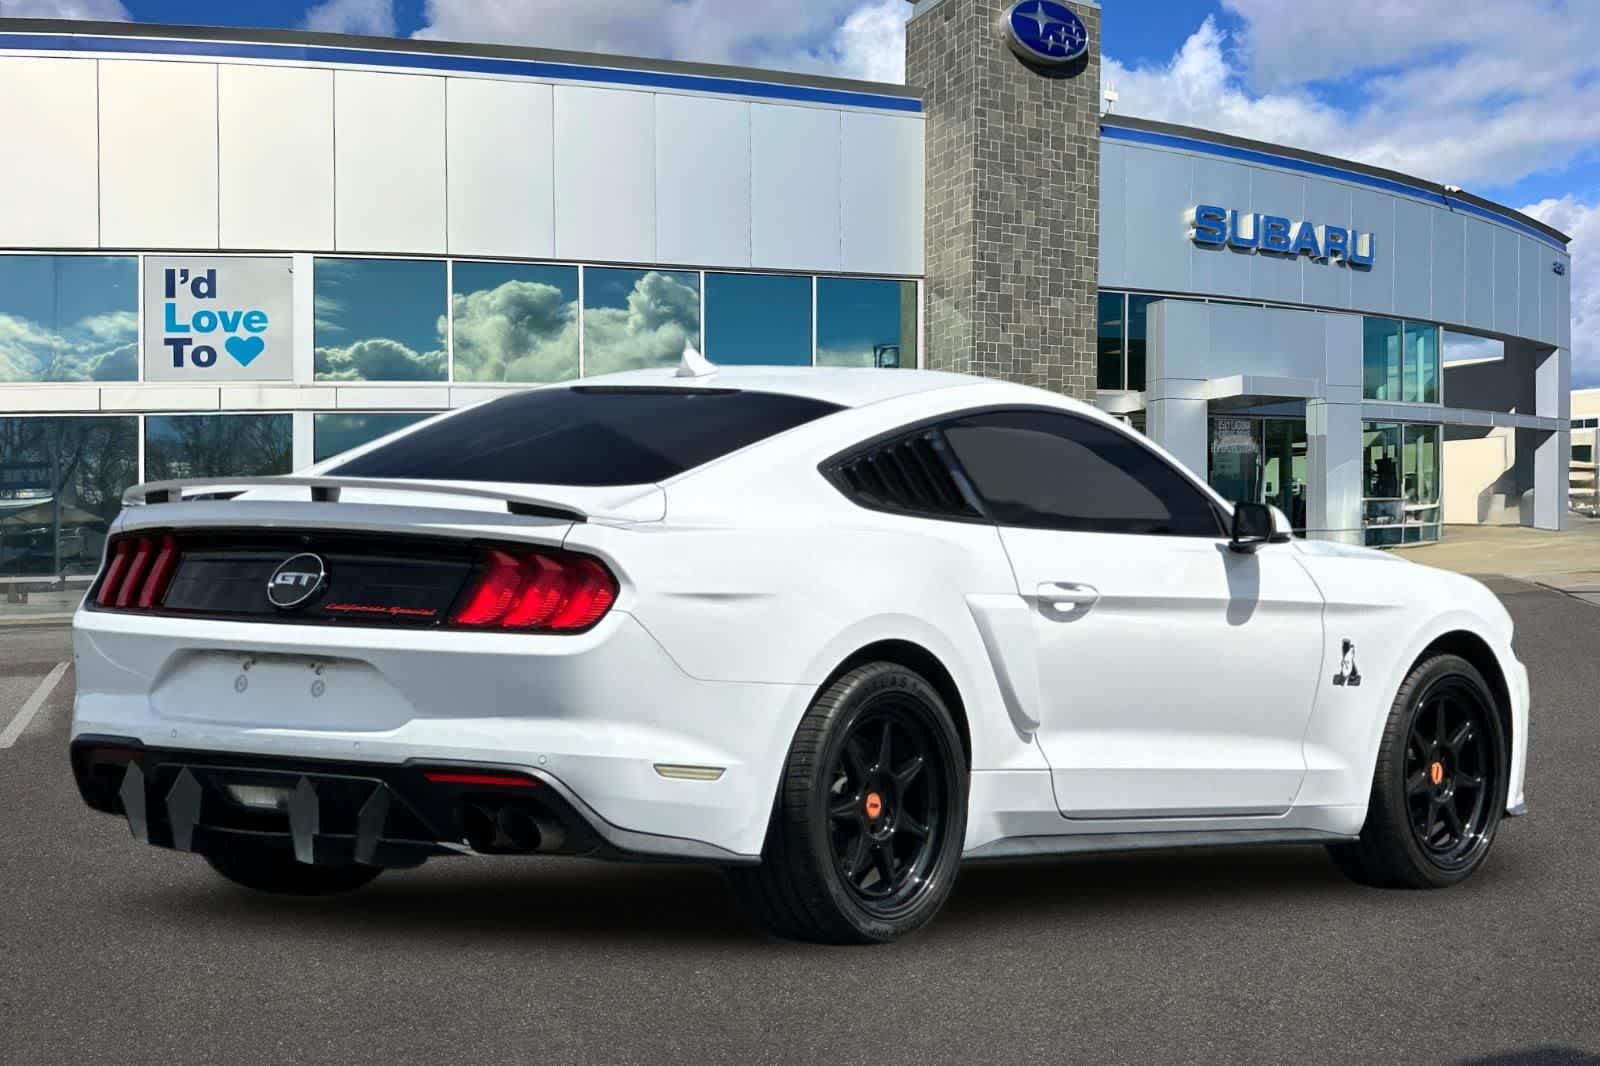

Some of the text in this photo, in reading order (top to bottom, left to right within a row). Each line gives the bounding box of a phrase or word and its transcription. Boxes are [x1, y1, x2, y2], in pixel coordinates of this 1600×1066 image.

[1191, 204, 1376, 267] SUBARU
[165, 269, 217, 299] I’d
[165, 302, 268, 333] Love
[164, 338, 217, 368] To
[275, 572, 318, 586] GT
